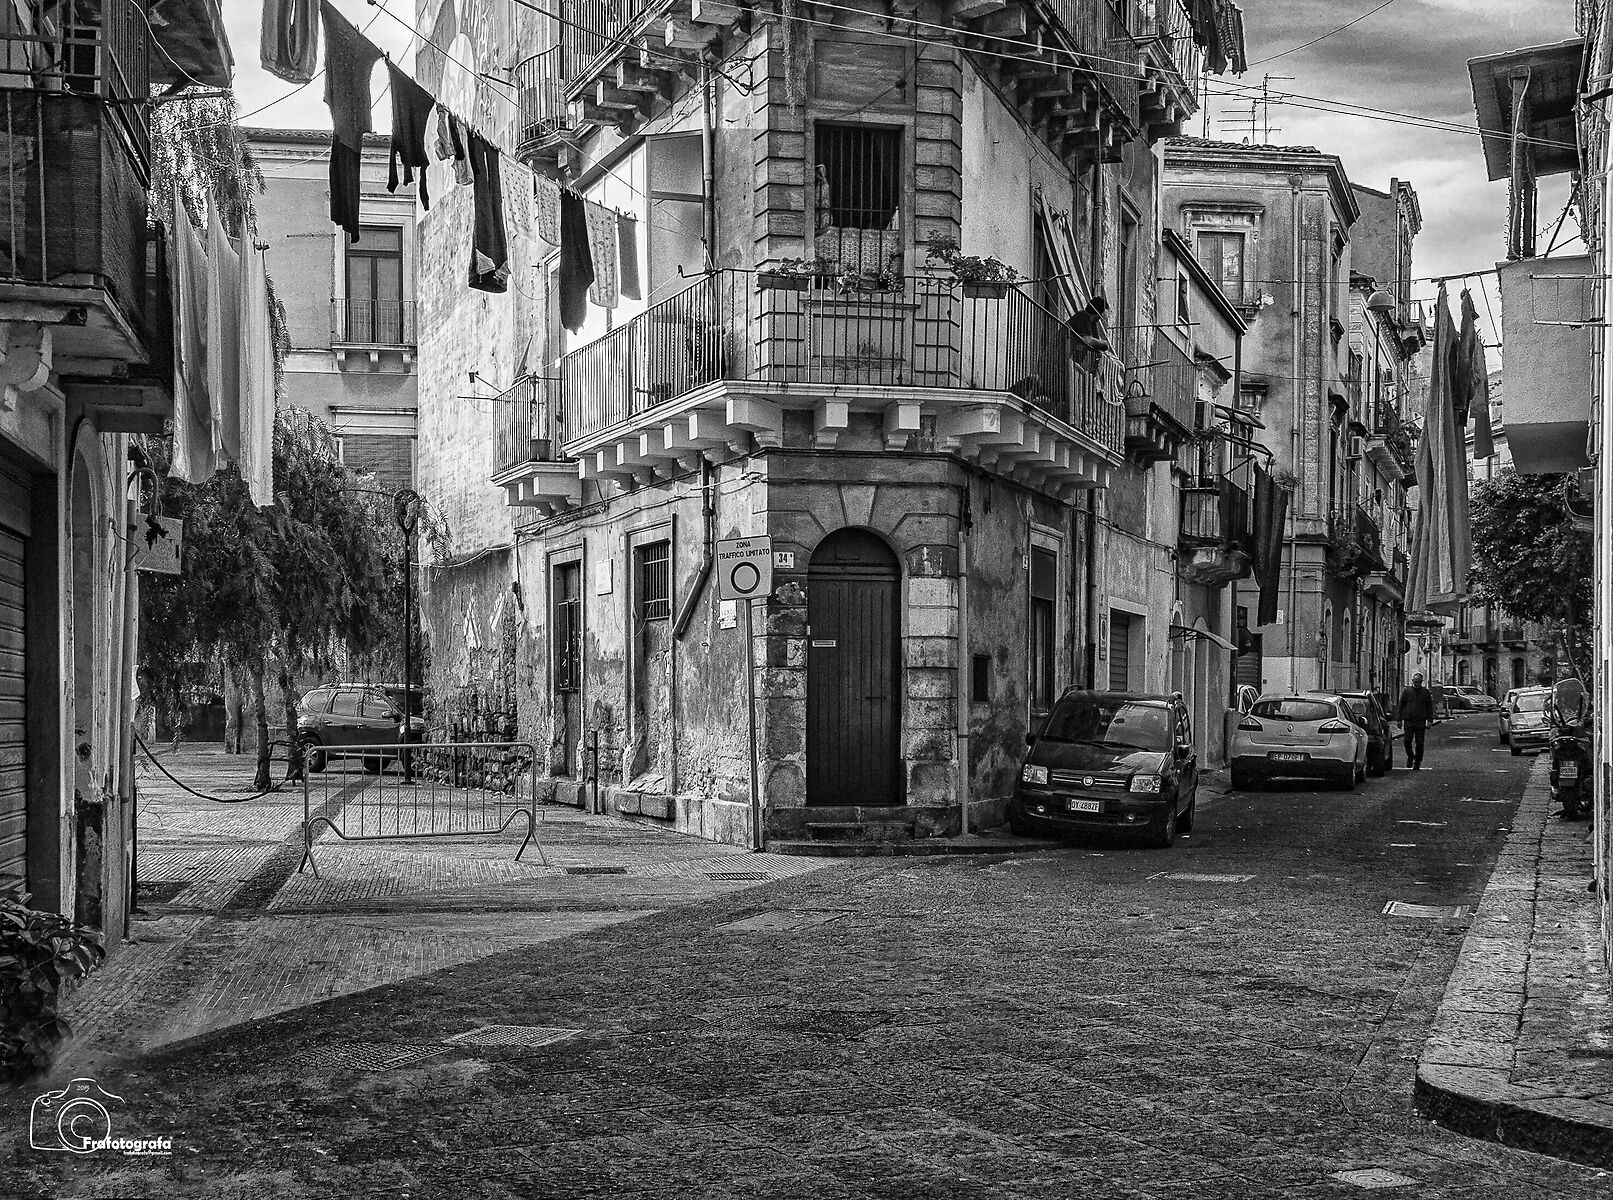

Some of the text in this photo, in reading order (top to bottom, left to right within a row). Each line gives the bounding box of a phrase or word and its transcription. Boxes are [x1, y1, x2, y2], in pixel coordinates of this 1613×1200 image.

[736, 541, 751, 549] ZONA
[719, 548, 770, 560] TRAFFICO LIMITATO
[778, 553, 788, 563] 34
